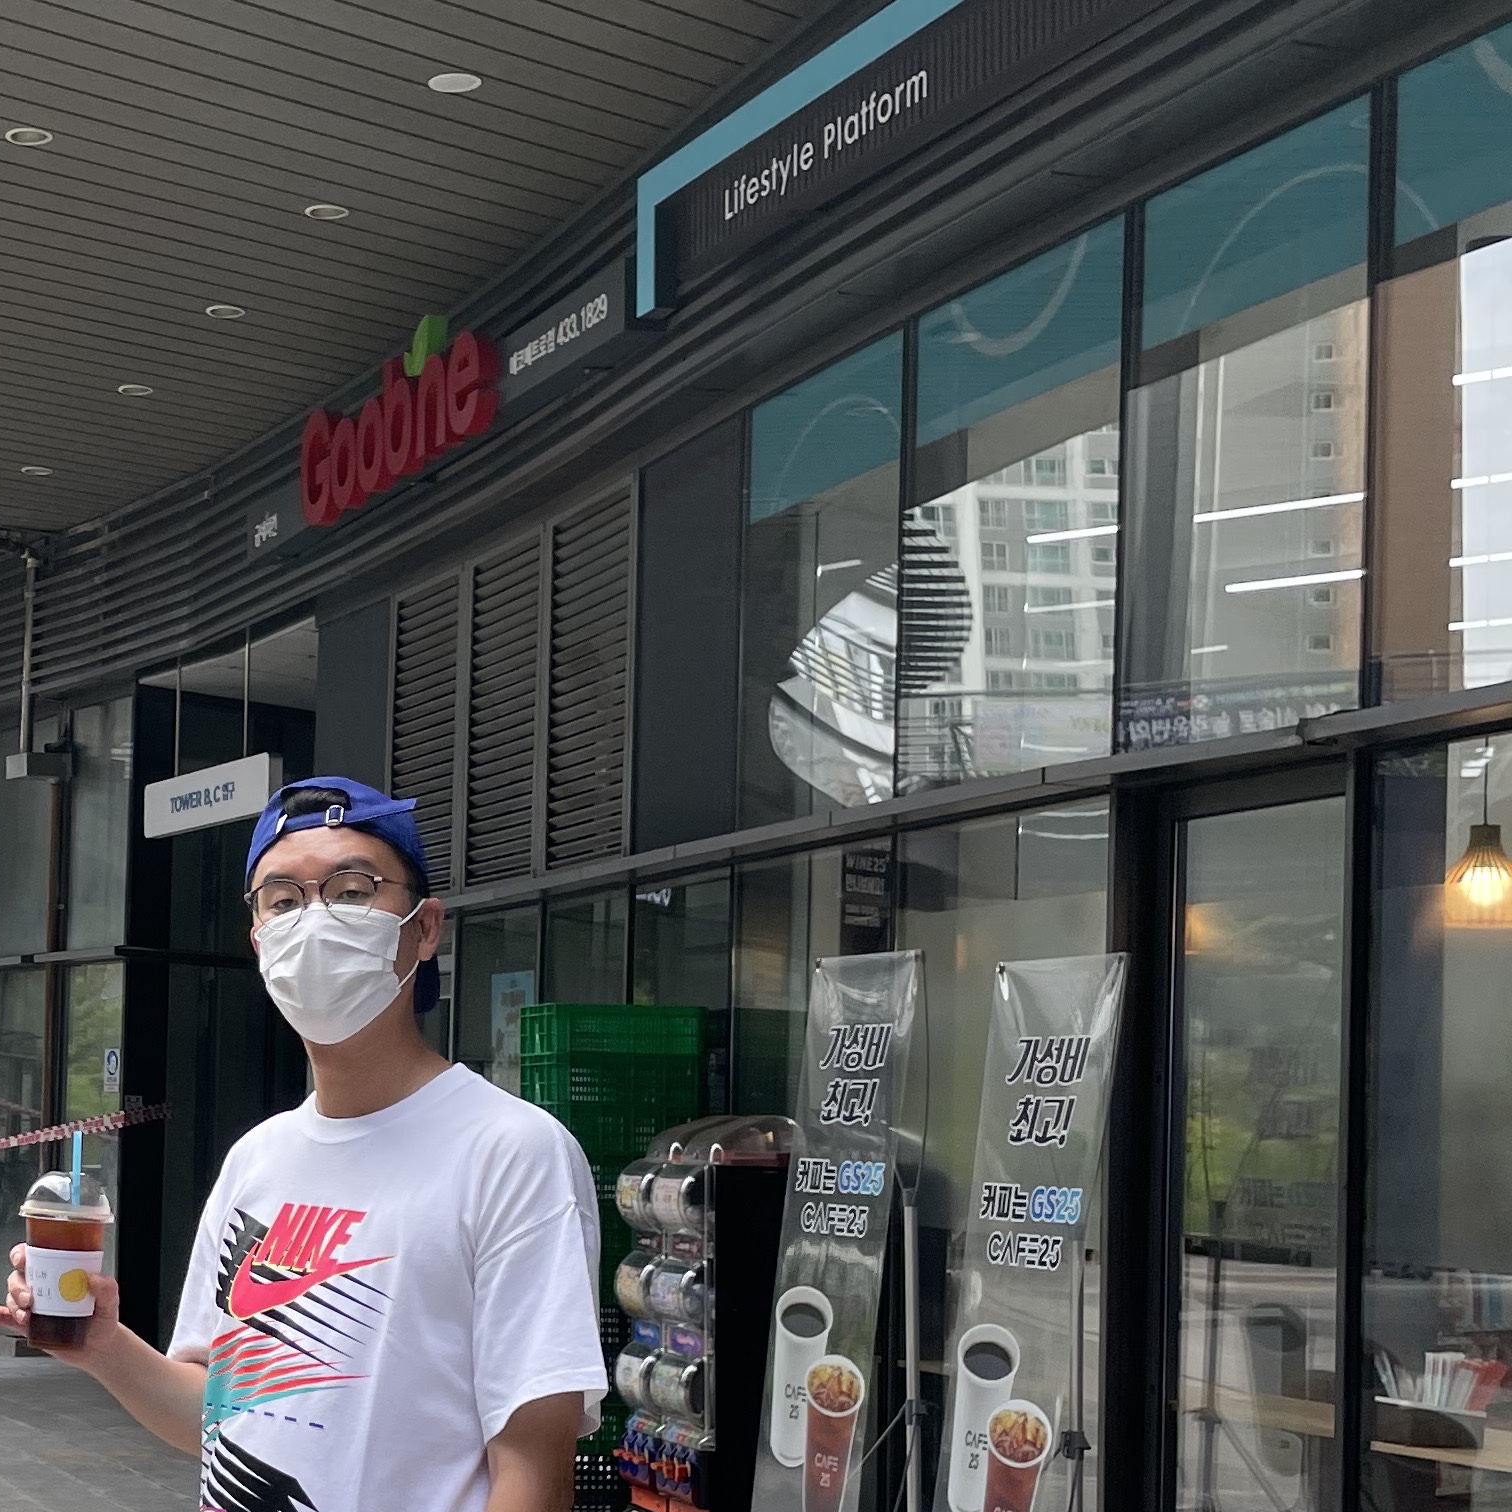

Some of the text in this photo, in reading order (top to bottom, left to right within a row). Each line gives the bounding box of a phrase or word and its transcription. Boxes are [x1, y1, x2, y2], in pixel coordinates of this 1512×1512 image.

[724, 69, 928, 220] Lifestyle Platform
[557, 293, 607, 345] 433.1829
[301, 331, 488, 525] Goobne
[170, 790, 202, 814] TOWER
[213, 785, 221, 803] C
[819, 1023, 893, 1072] 가성비
[1005, 1034, 1092, 1087] 가성비
[820, 1078, 878, 1126] 최고!
[1007, 1094, 1078, 1149] 최고!
[795, 1157, 885, 1197] 커피는 GS25
[799, 1201, 869, 1239] CAFE25
[980, 1181, 1083, 1226] 커피는 GS25
[255, 1202, 367, 1273] NIKE
[987, 1231, 1063, 1271] CAFE25
[788, 1403, 799, 1420] 25
[965, 1430, 988, 1451] CAFE
[814, 1452, 839, 1472] CAFE
[819, 1471, 831, 1488] 25
[968, 1453, 980, 1471] 25
